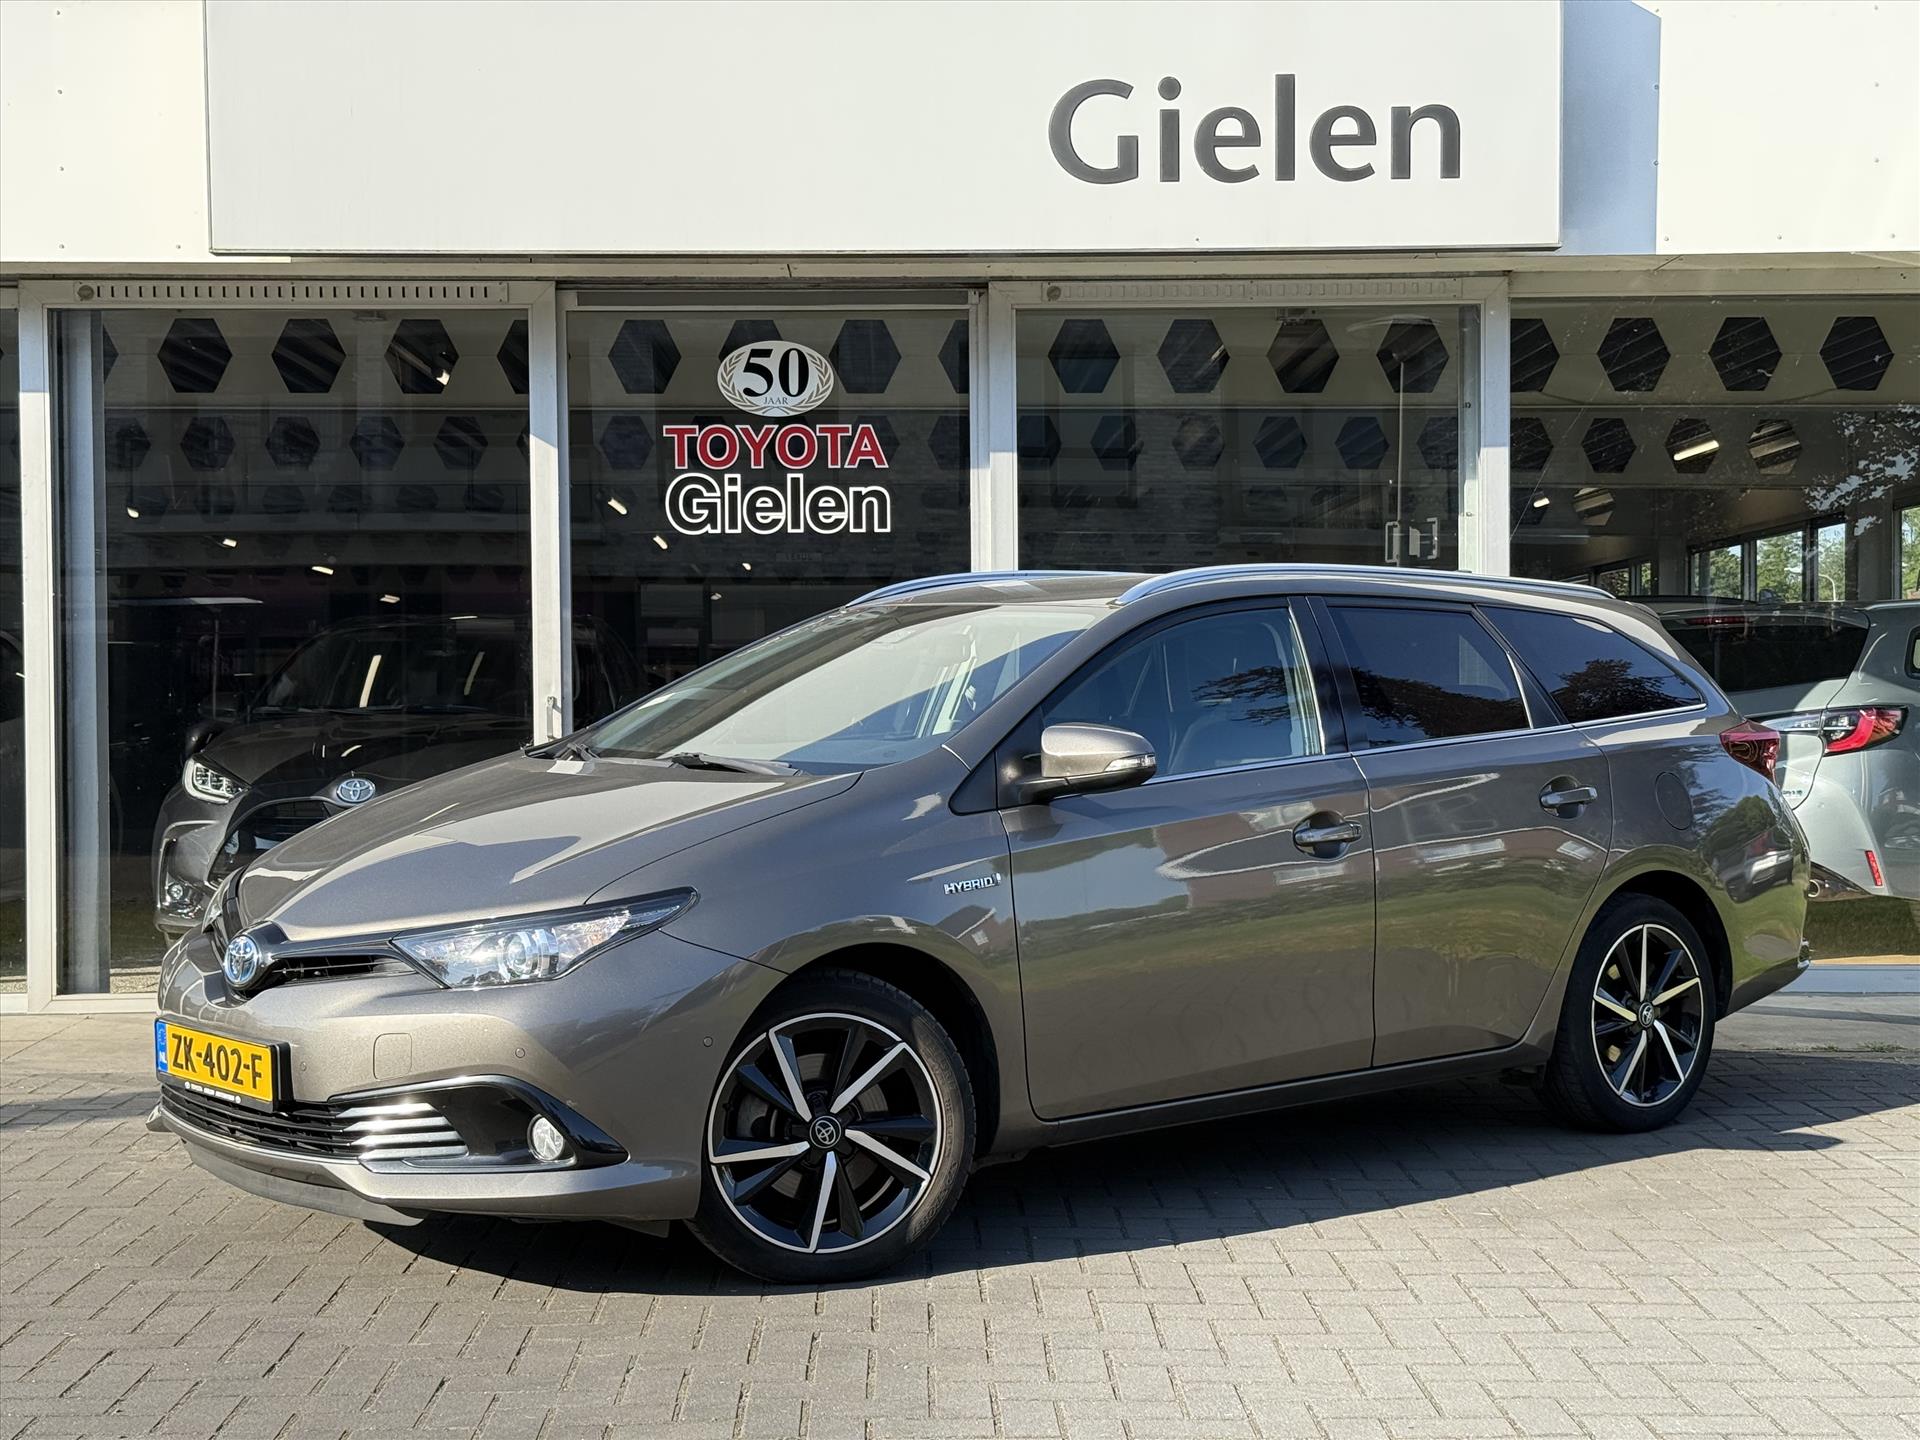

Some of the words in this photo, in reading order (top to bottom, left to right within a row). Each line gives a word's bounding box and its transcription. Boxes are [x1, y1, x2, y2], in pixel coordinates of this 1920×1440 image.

[1048, 73, 1460, 184] Gielen
[742, 347, 810, 398] 50
[764, 396, 789, 405] JAAR
[663, 424, 889, 470] TOYOTA
[665, 472, 891, 535] Gielen
[944, 876, 995, 895] HYBRID
[171, 1032, 263, 1090] ZK-402-F
